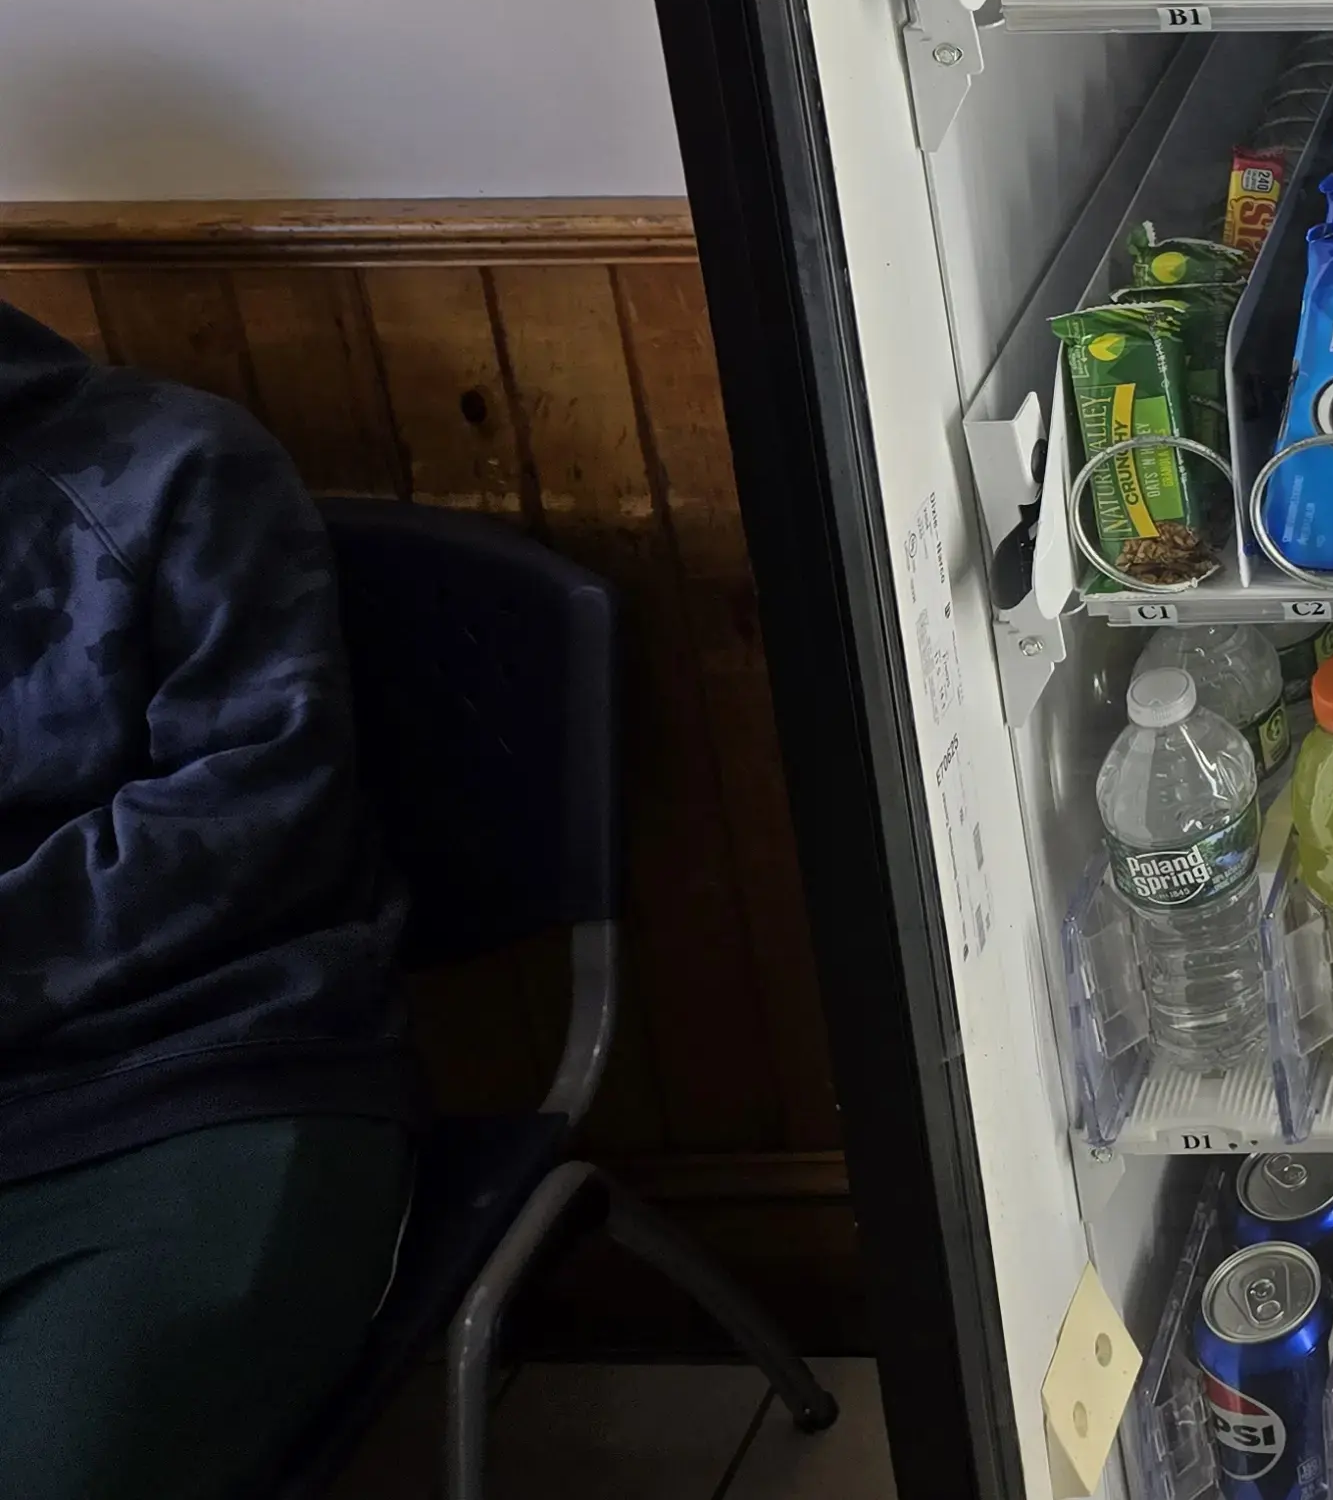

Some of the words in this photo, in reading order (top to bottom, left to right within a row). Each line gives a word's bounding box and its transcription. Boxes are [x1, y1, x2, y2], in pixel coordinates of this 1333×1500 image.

[1168, 8, 1203, 26] B1
[1158, 450, 1175, 488] GRANOLA
[1144, 472, 1161, 498] OATS
[1091, 462, 1133, 534] NATURE
[1137, 604, 1171, 620] C1
[1291, 601, 1326, 617] C2
[1126, 844, 1204, 877] Poland
[1132, 863, 1212, 897] Spring
[1169, 888, 1190, 899] 1845
[1182, 1135, 1213, 1149] D1
